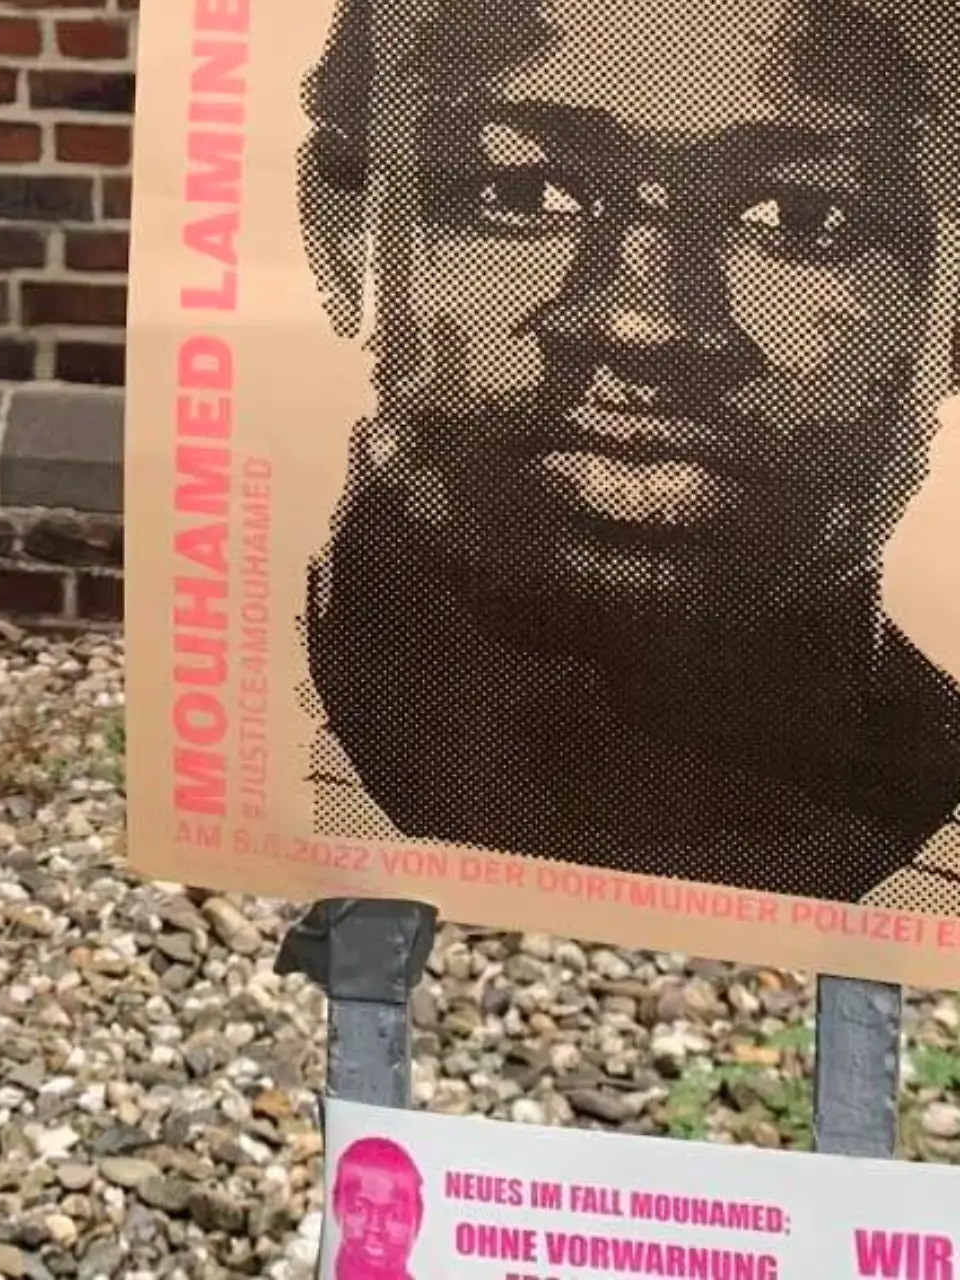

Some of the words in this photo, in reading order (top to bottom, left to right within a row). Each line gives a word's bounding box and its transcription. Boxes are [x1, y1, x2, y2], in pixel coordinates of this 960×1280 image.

[173, 335, 233, 818] MOUHAMED
[174, 822, 221, 850] AM
[381, 849, 449, 877] VON
[459, 859, 526, 888] DER
[540, 865, 779, 924] DORTMUNDER
[792, 902, 924, 943] POLIZEI
[445, 1170, 524, 1207] NEUES
[530, 1181, 563, 1210] IM
[569, 1185, 624, 1217] FALL
[630, 1191, 791, 1236] MOUHAMED:
[455, 1221, 538, 1263] OHNE
[545, 1231, 778, 1280] VORWARNUNG
[855, 1227, 954, 1280] WIR
